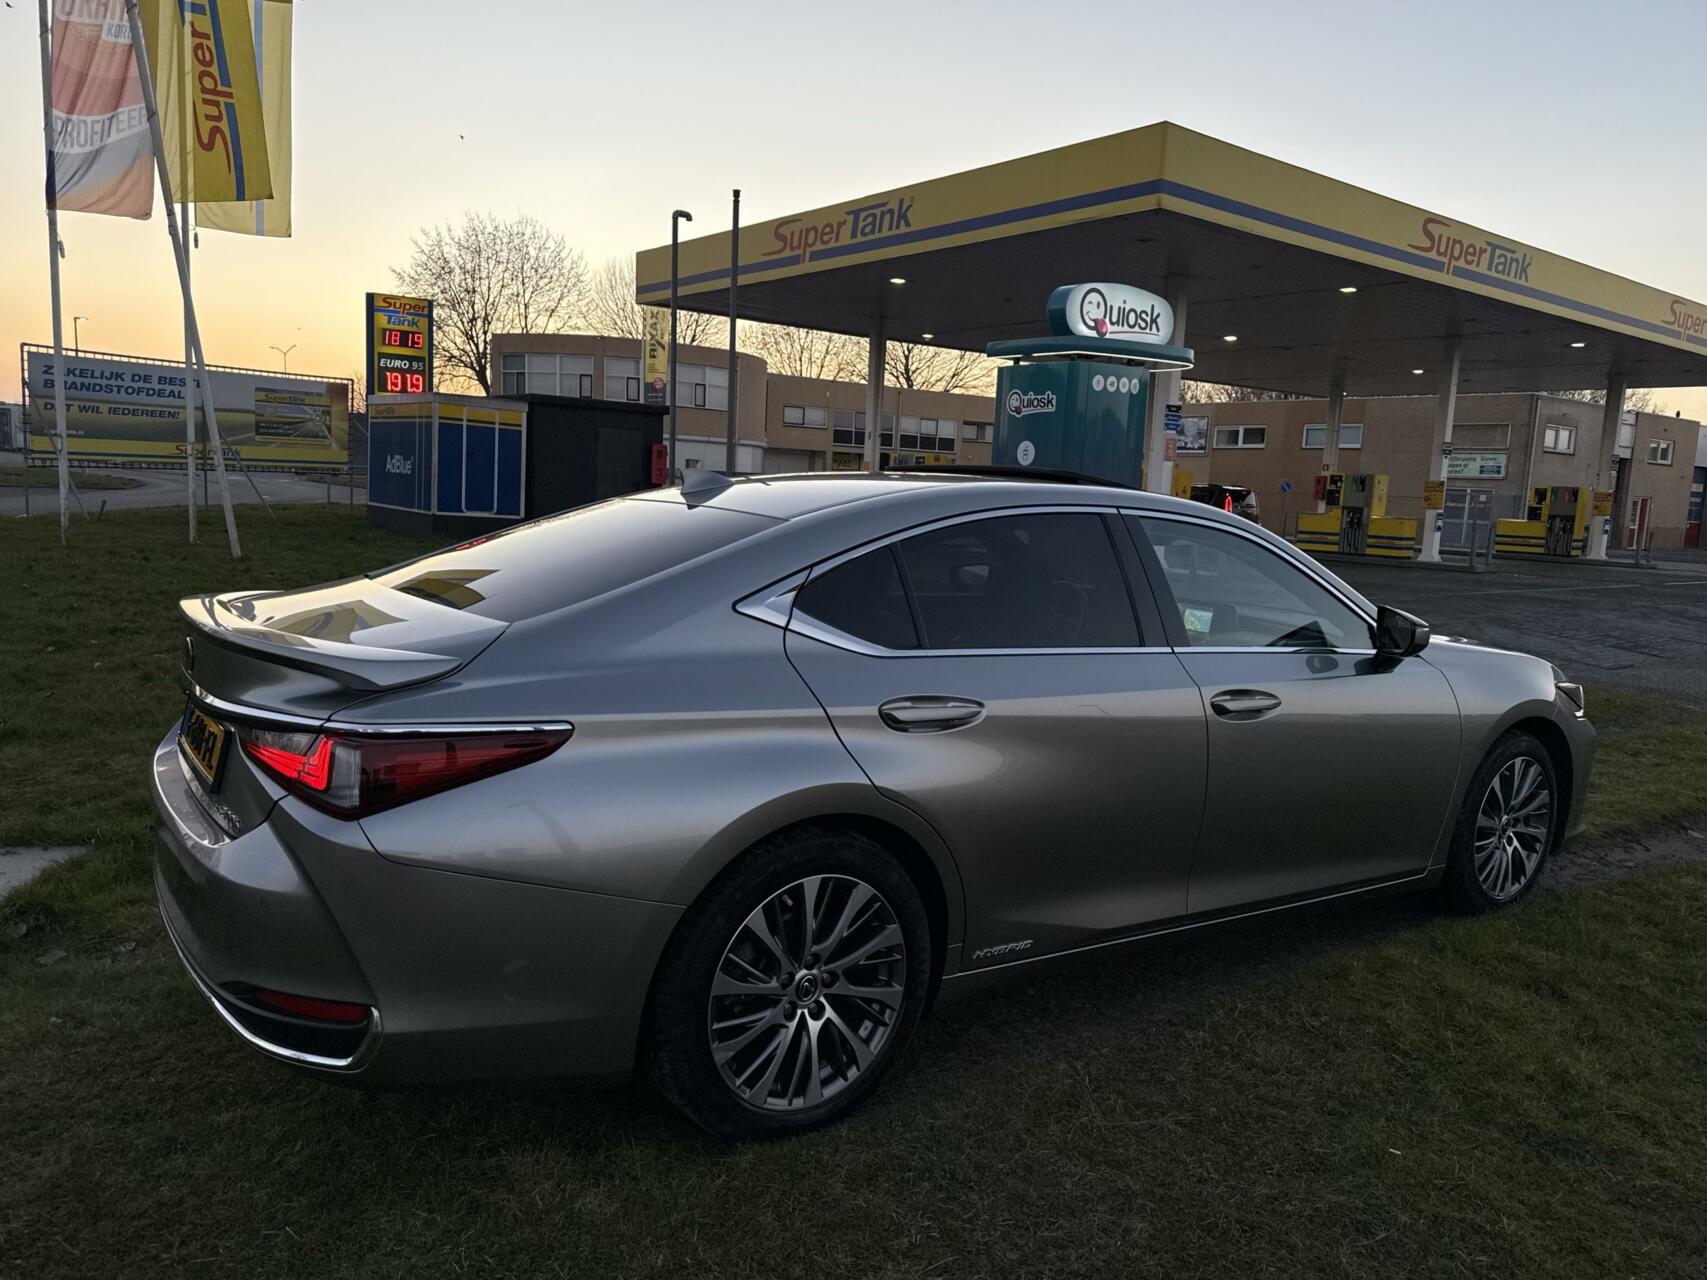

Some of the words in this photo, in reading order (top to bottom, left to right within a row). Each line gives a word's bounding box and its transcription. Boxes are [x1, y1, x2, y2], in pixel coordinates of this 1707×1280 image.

[761, 198, 914, 264] SuperTank
[1407, 216, 1533, 283] SuperTank
[374, 296, 428, 315] Super
[1080, 288, 1161, 337] Quiosk
[384, 313, 420, 328] Tank
[380, 358, 409, 369] EURO
[411, 361, 424, 370] 95
[42, 365, 126, 382] ZKELIJK
[130, 373, 153, 384] DE
[43, 401, 74, 412] DT
[78, 404, 104, 415] WIL
[107, 406, 181, 419] IEDEREEN!
[1008, 391, 1055, 416] Quiosk
